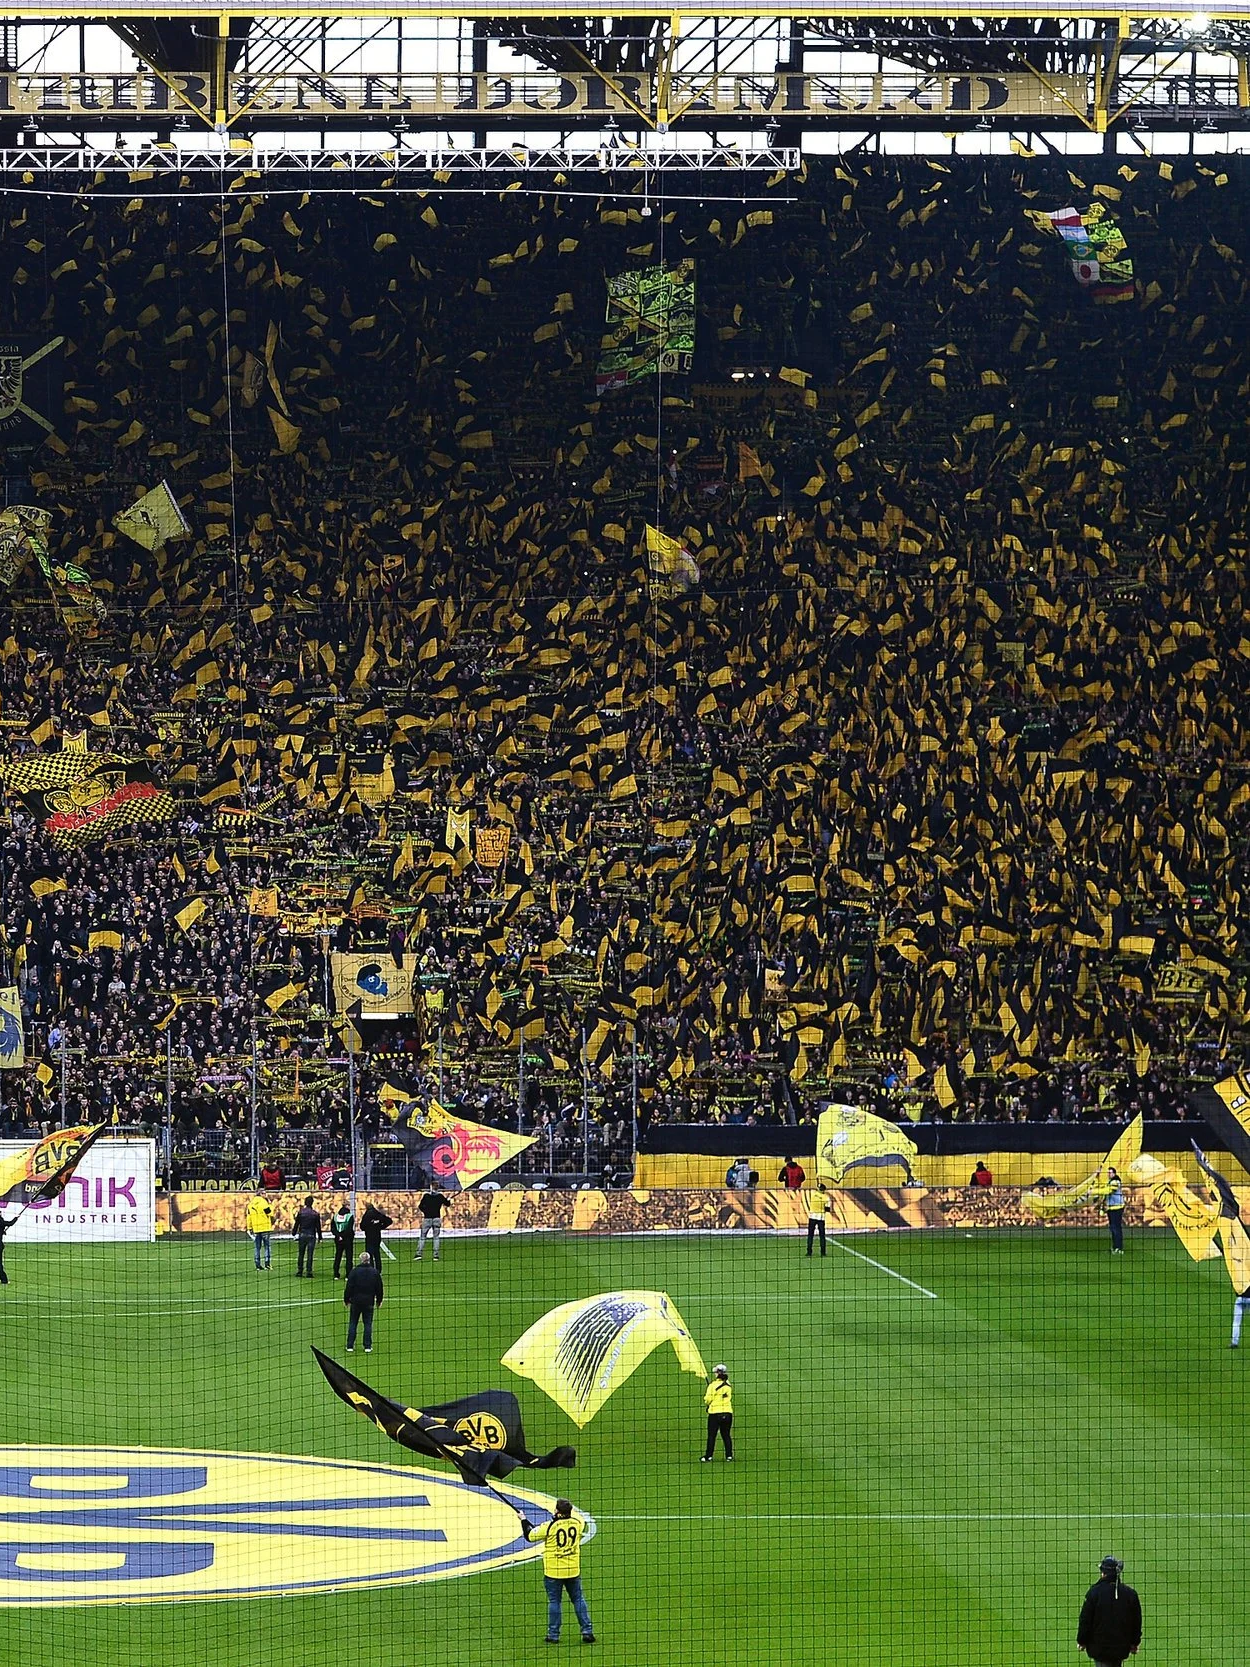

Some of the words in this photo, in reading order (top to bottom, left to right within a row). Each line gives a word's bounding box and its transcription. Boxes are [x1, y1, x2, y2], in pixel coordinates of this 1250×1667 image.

[35, 1214, 138, 1224] INDUSTRIES
[461, 1416, 499, 1445] BVB
[557, 1526, 577, 1548] 09
